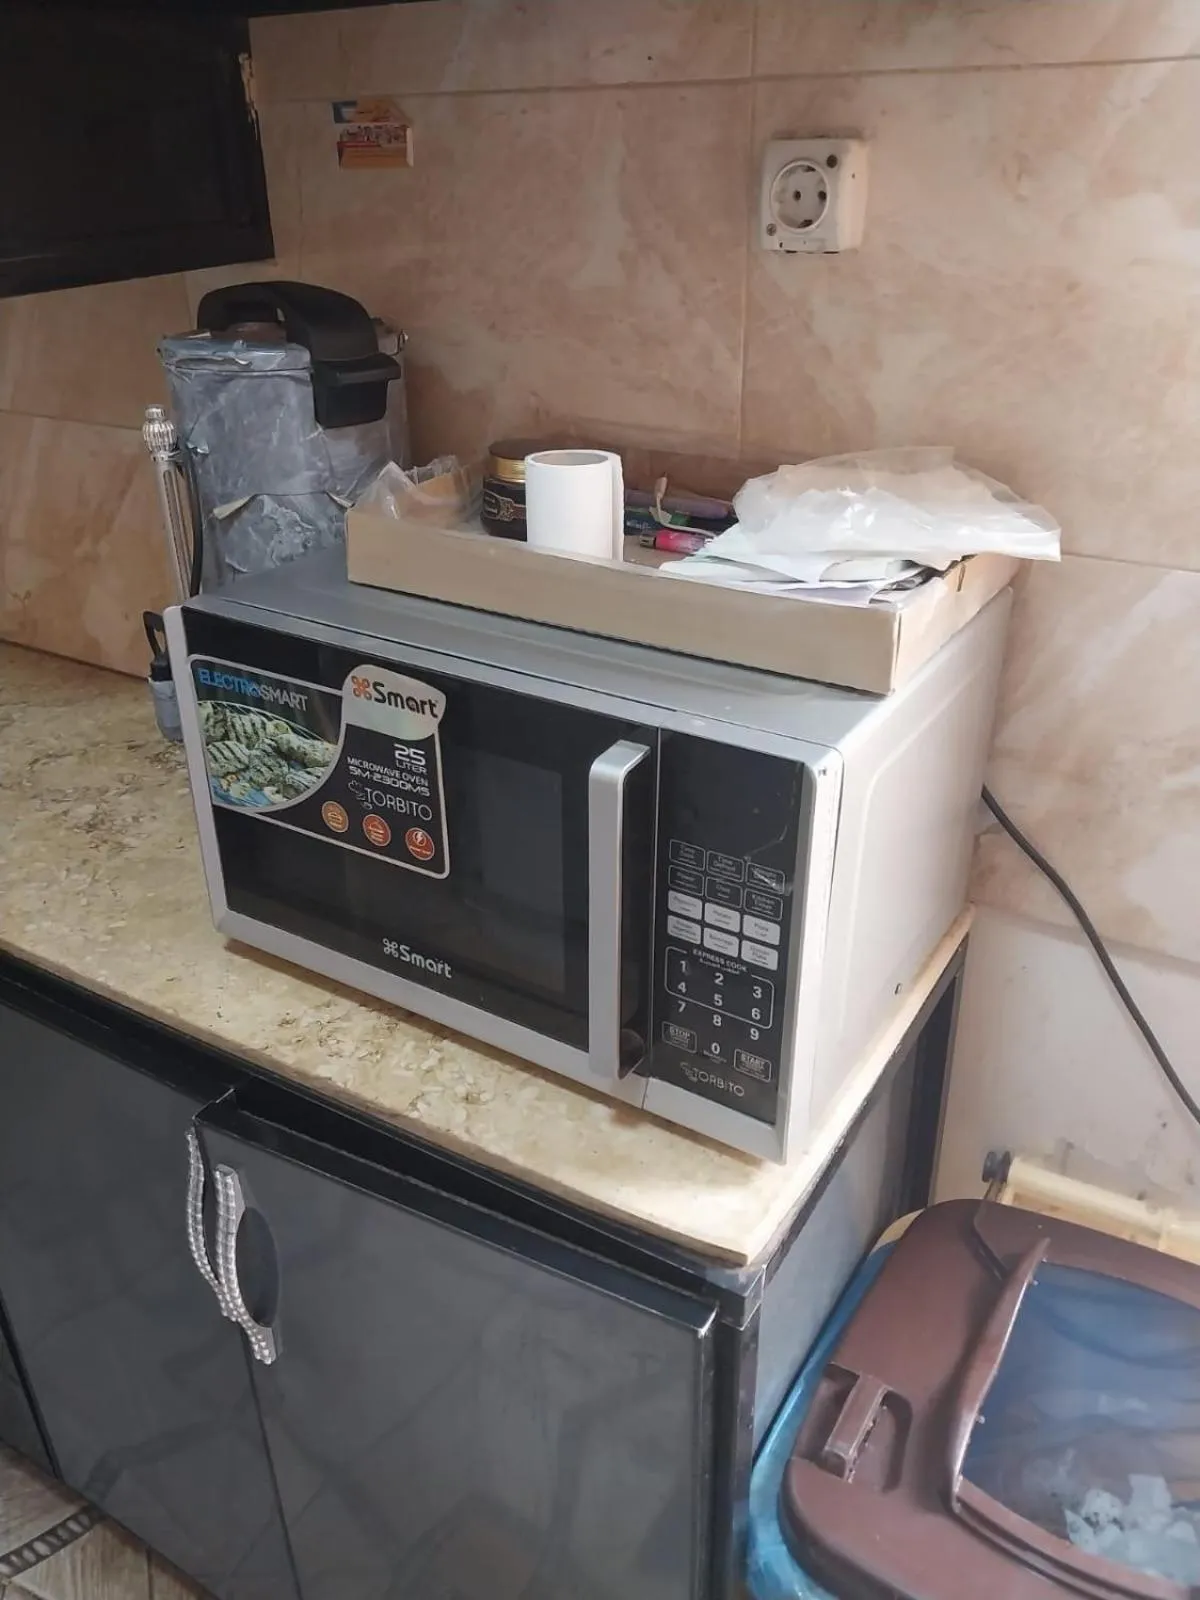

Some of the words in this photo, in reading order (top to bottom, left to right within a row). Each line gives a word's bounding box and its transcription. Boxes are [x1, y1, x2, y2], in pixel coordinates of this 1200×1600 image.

[198, 667, 308, 711] ELECTROSMART
[371, 680, 438, 718] Smart
[394, 743, 426, 766] 25
[347, 756, 401, 779] MICROWAVE
[401, 770, 429, 788] OVEN
[396, 760, 427, 775] LITER
[364, 787, 433, 821] TORBITO
[399, 944, 453, 979] Smart
[679, 960, 688, 974] 1
[713, 972, 725, 987] 2
[677, 981, 688, 995] 4
[752, 985, 763, 1000] 3
[677, 1000, 687, 1014] 7
[713, 993, 724, 1008] 5
[712, 1014, 723, 1028] 8
[751, 1007, 762, 1022] 6
[750, 1027, 760, 1042] 9
[711, 1042, 721, 1056] 0
[692, 1067, 745, 1097] TORBITO
